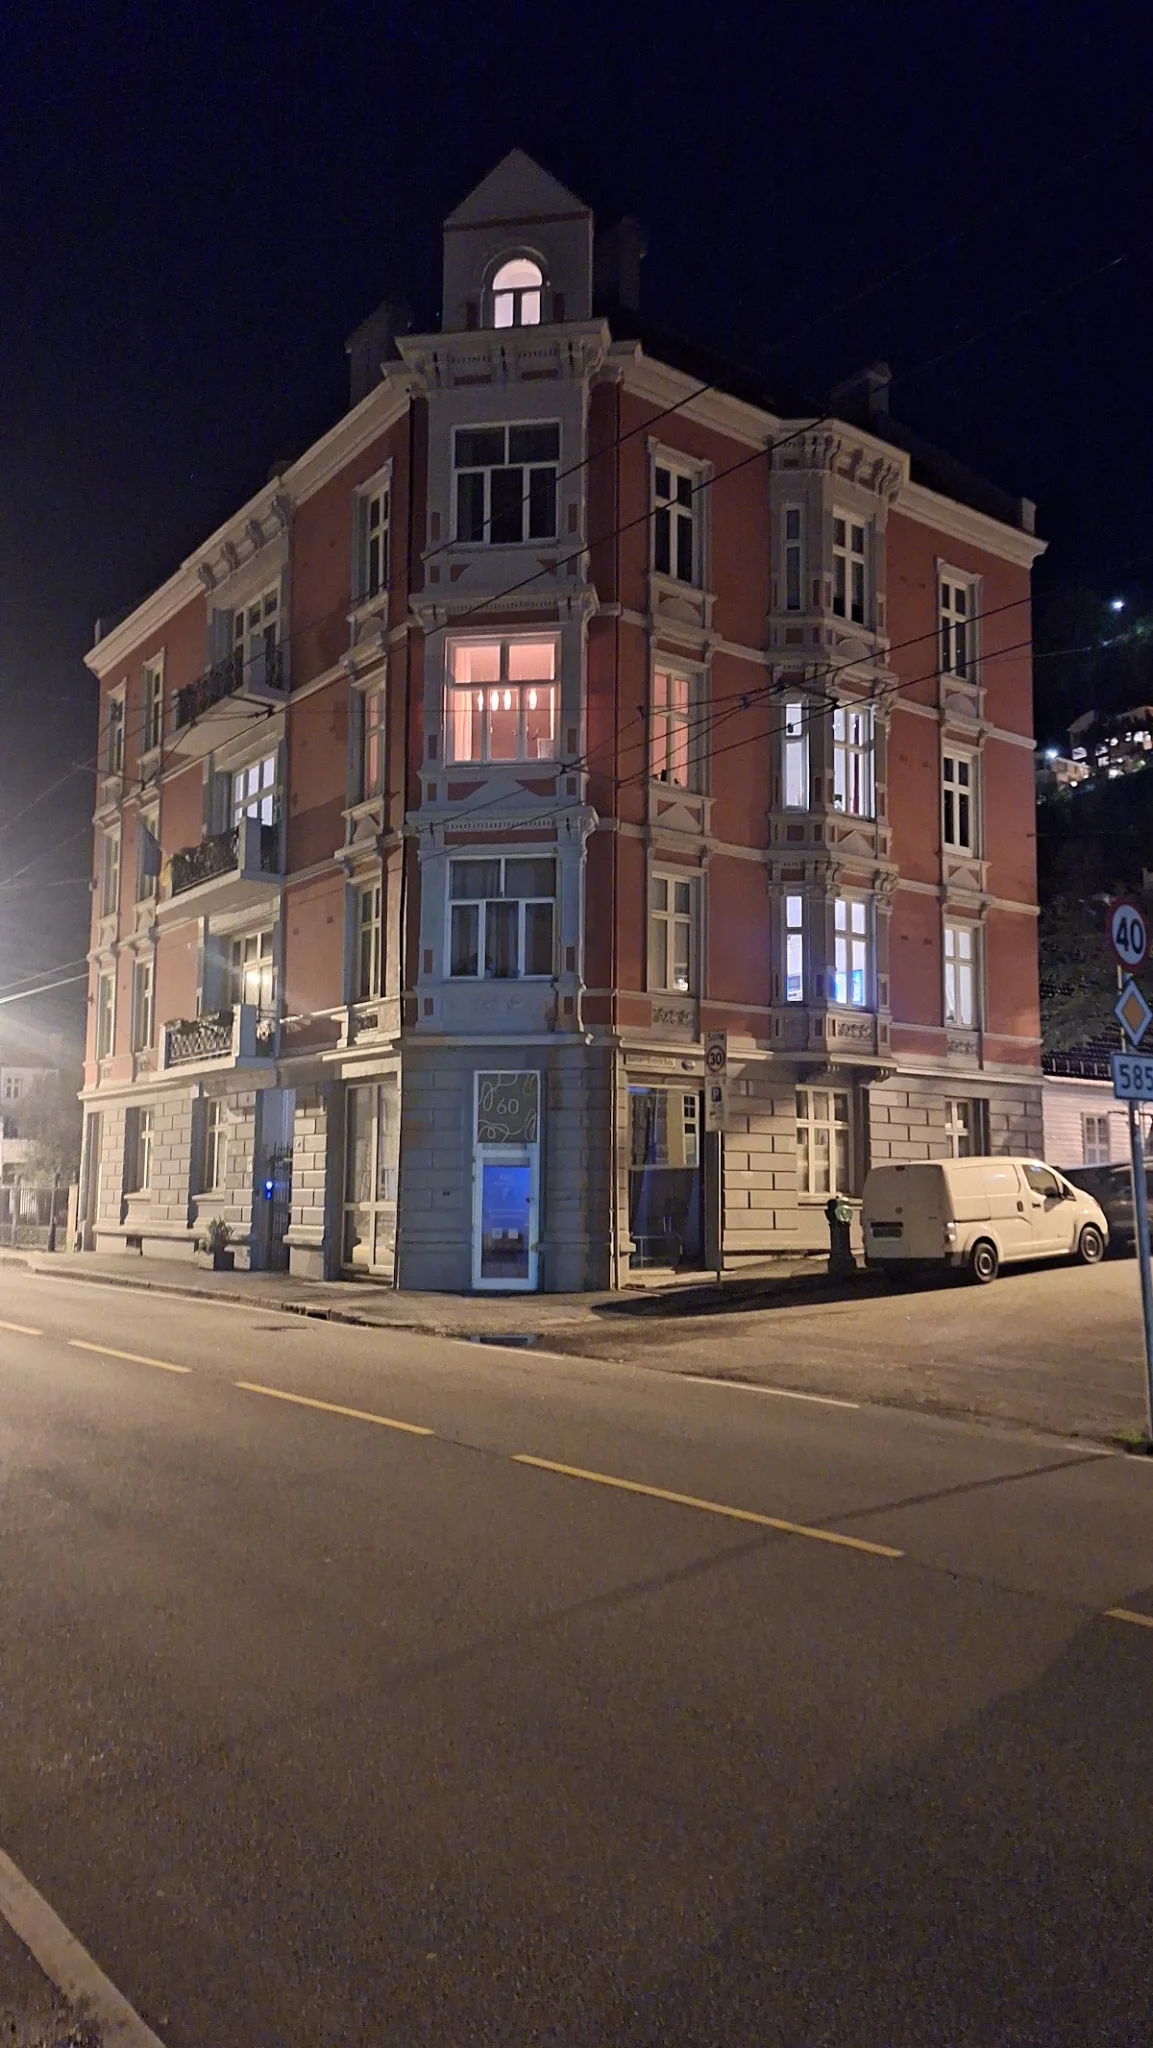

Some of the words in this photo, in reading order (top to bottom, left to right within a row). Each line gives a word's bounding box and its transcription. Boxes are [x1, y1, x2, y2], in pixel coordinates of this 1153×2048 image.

[1116, 916, 1144, 954] 40
[710, 1052, 723, 1066] 30
[1119, 1063, 1153, 1092] 585
[496, 1096, 520, 1115] 60
